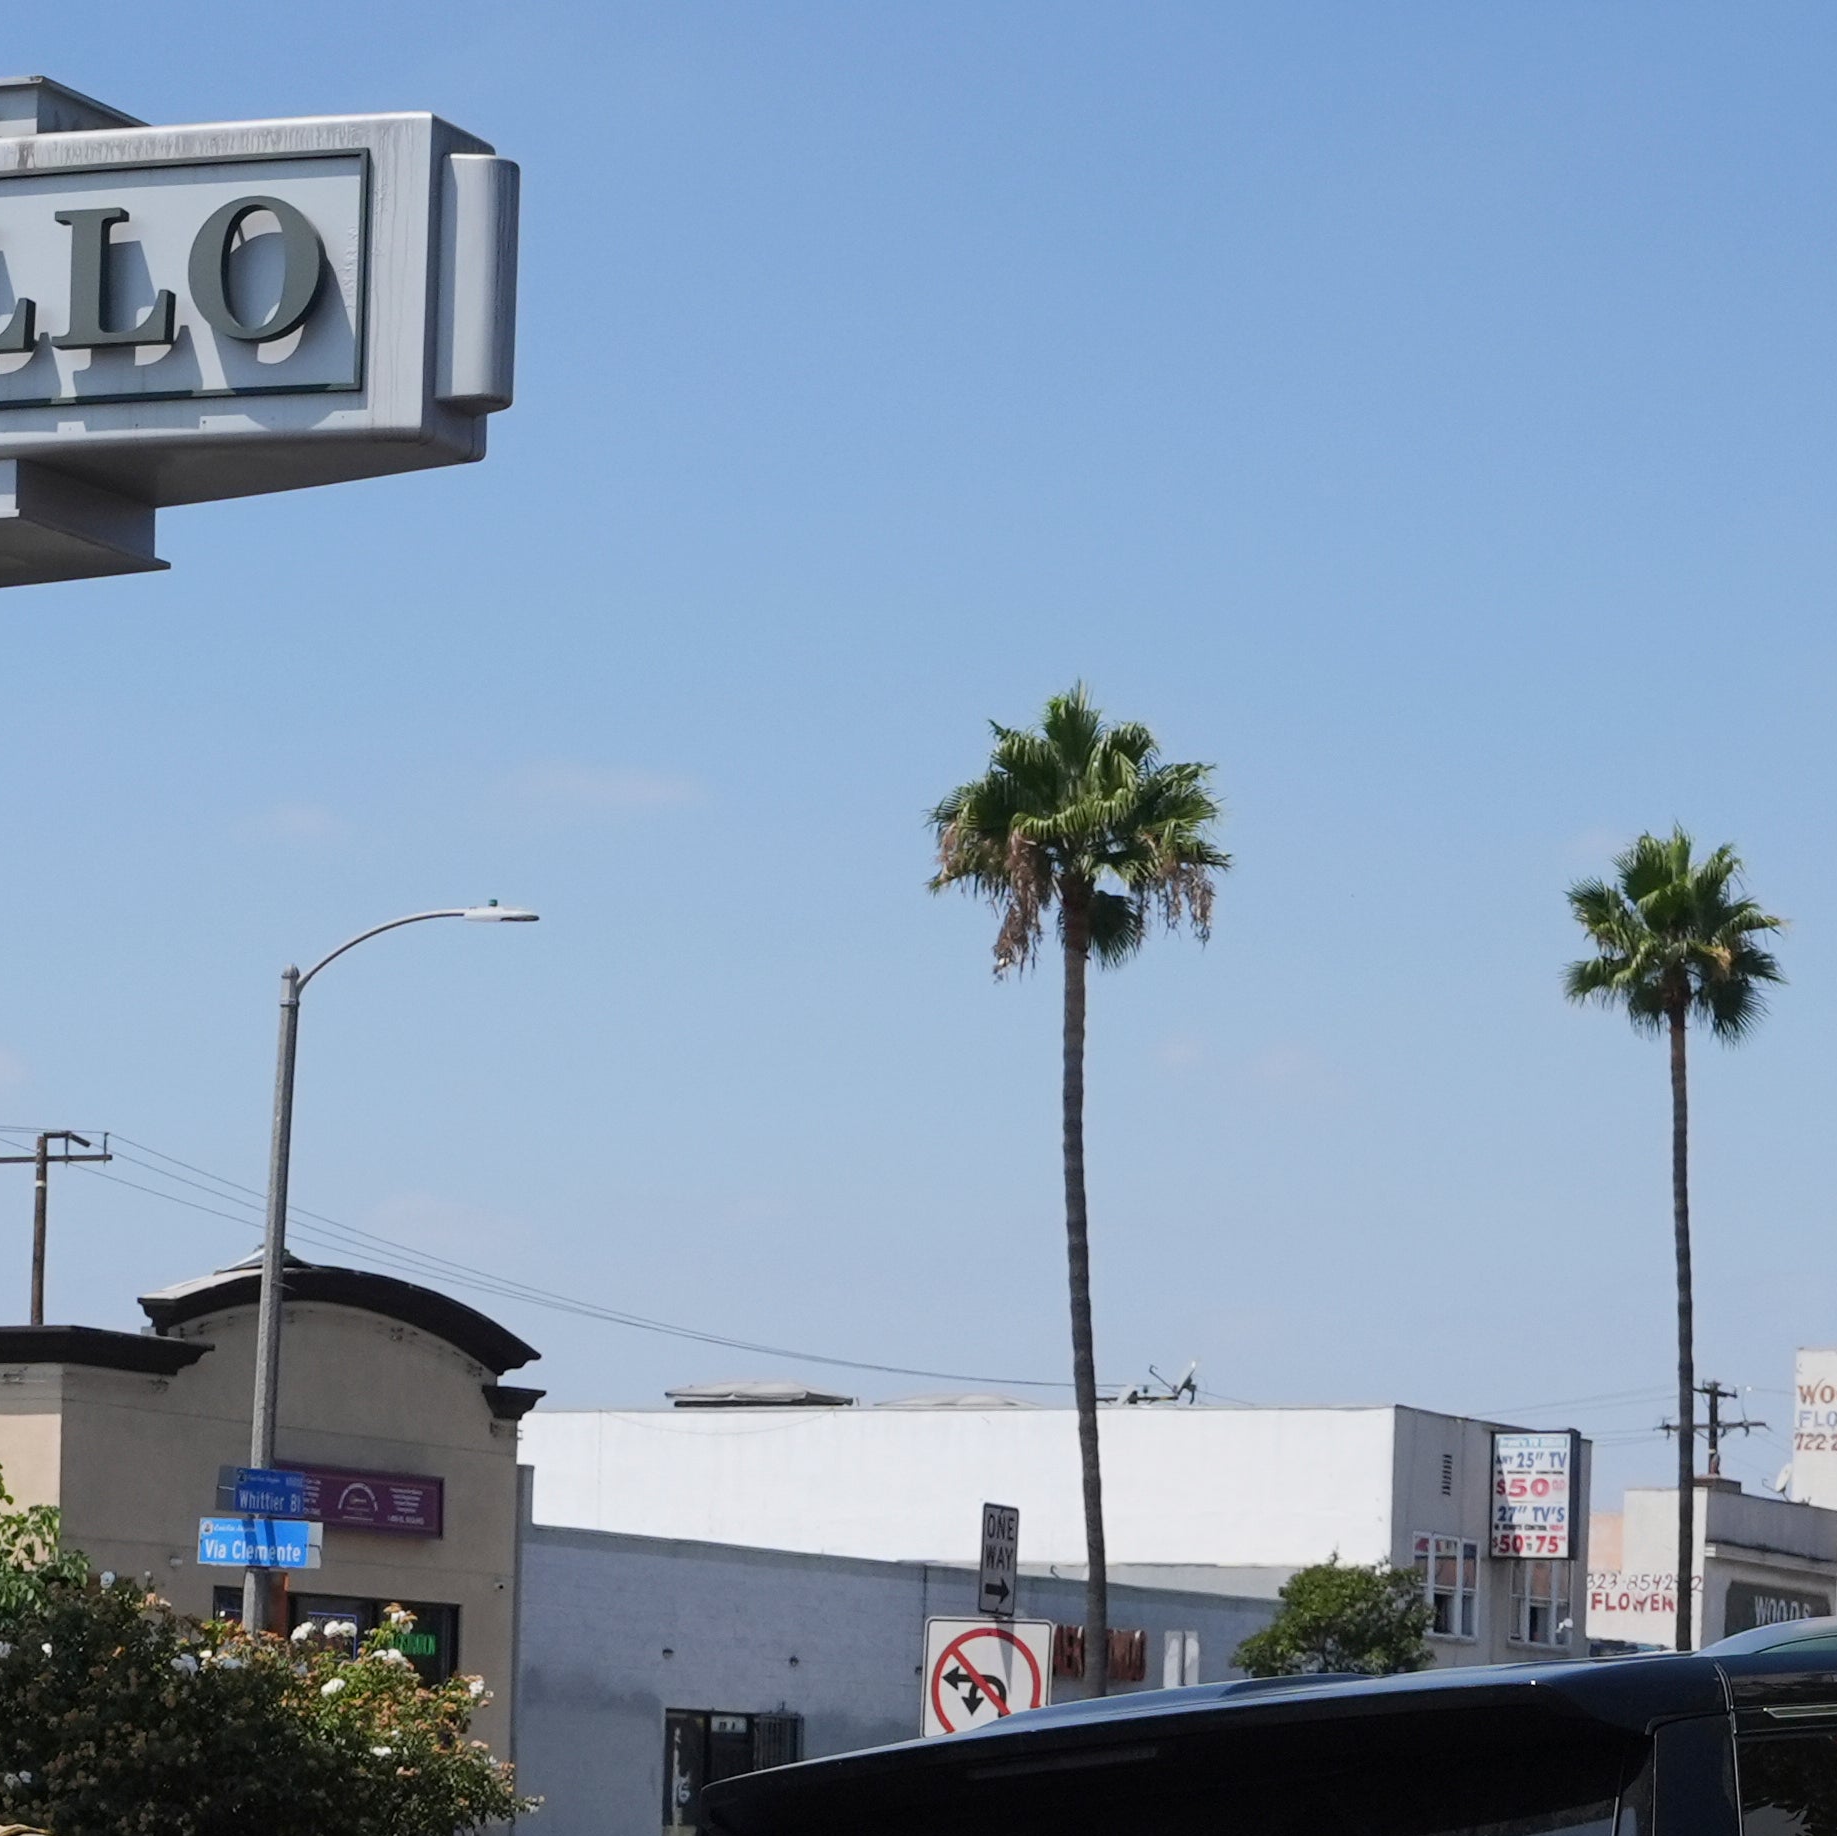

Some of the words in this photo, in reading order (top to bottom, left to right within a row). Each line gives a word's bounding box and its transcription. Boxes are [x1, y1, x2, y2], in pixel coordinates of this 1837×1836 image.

[1550, 1452, 1567, 1468] TV
[1496, 1477, 1551, 1499] $50
[239, 1490, 285, 1511] Whittier
[987, 1513, 1014, 1541] ONE
[205, 1539, 227, 1559] Via
[232, 1540, 302, 1562] Clemente
[985, 1544, 1014, 1572] WAY
